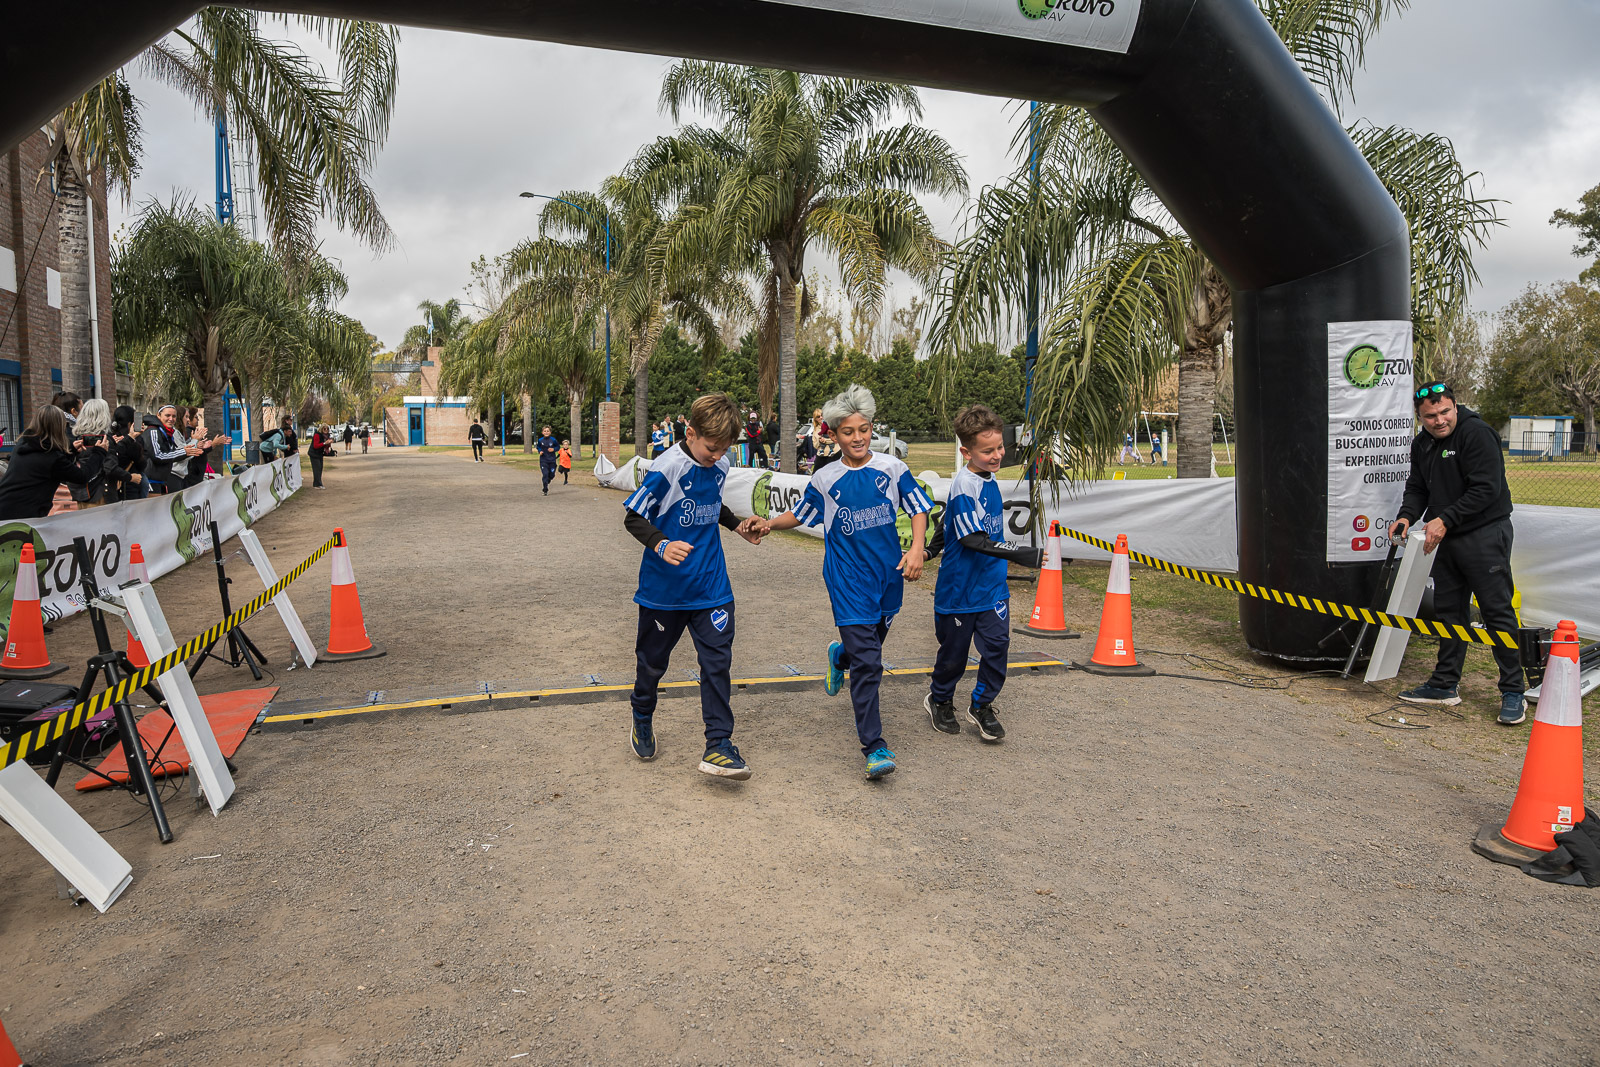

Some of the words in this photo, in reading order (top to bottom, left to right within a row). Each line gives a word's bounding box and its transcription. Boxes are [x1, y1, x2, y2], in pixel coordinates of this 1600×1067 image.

[1040, 10, 1066, 22] RAV
[1372, 377, 1396, 388] RAV
[1335, 435, 1387, 450] BUSCANDO
[1345, 452, 1405, 467] EXPERIENCIAS
[680, 498, 696, 527] 3
[837, 506, 855, 536] 3
